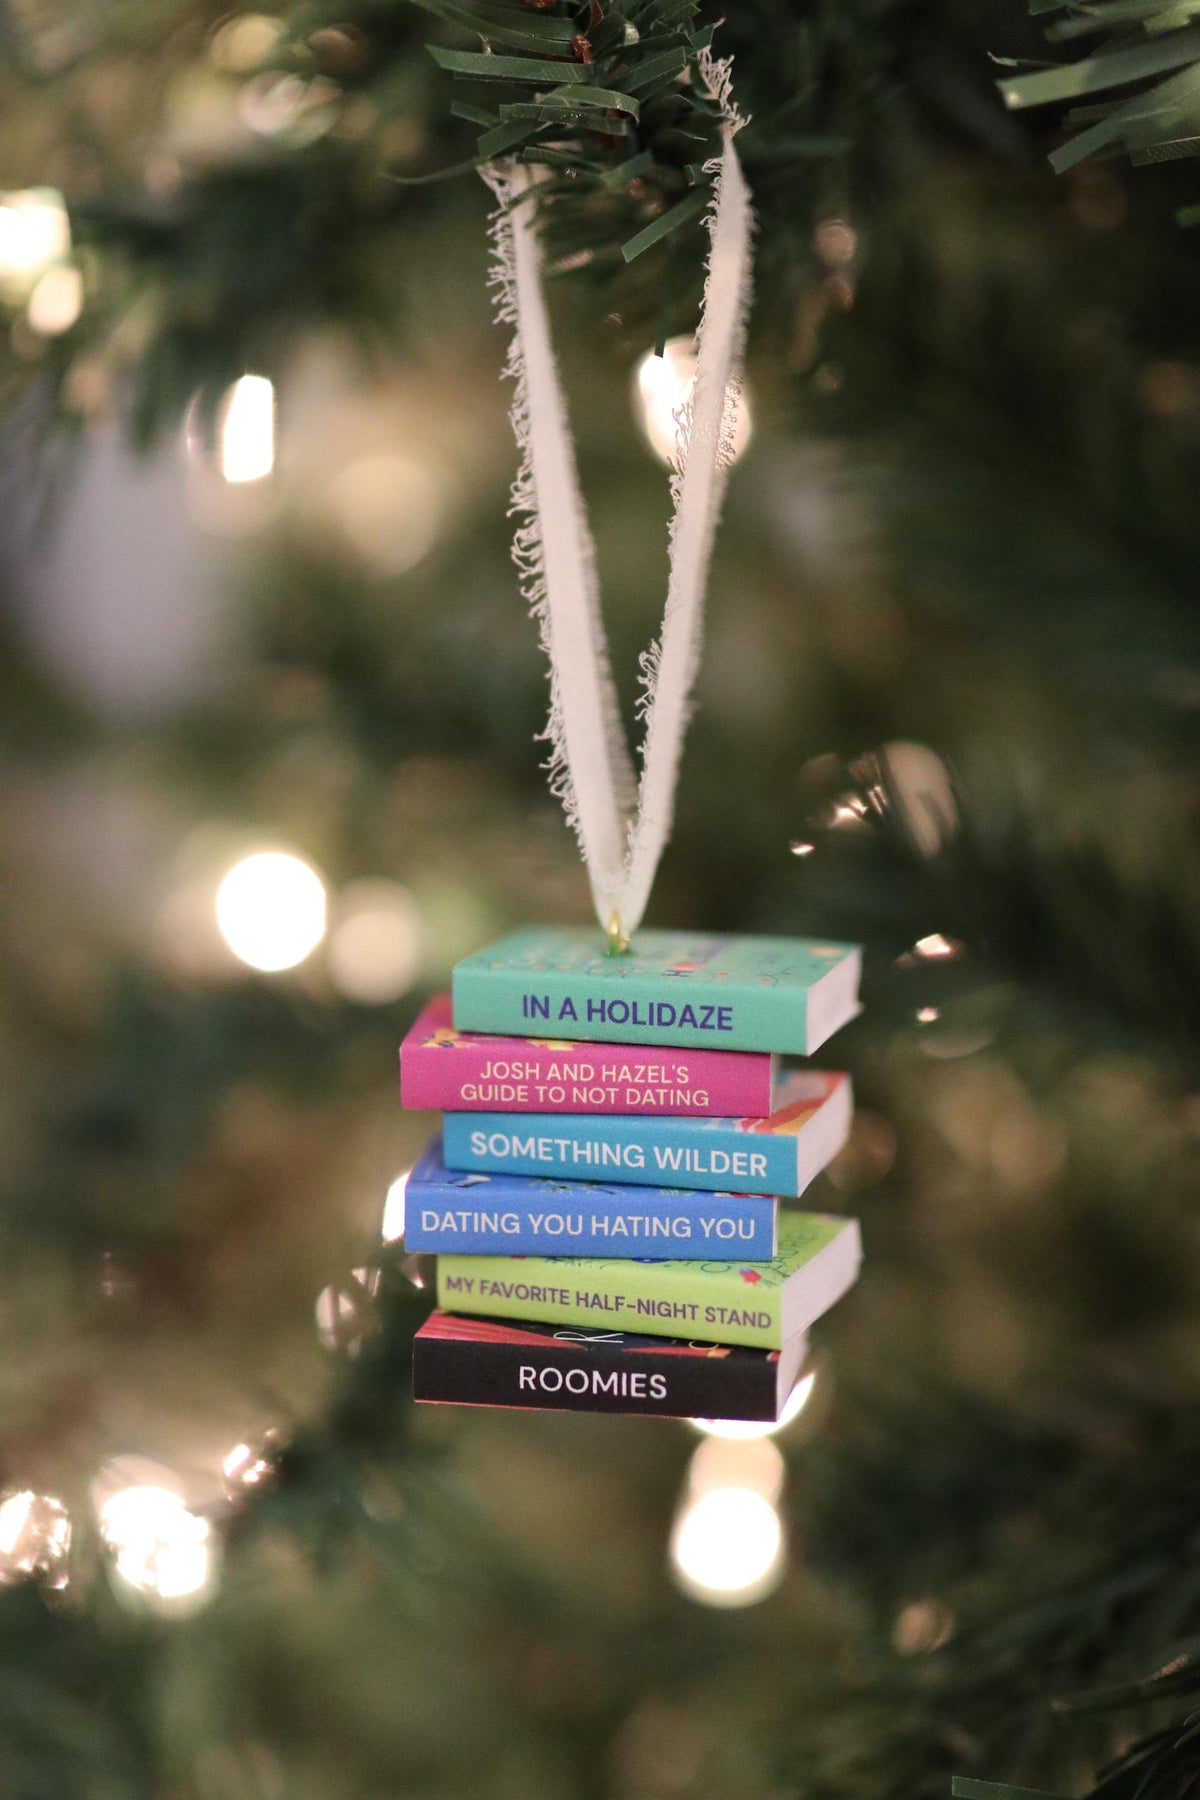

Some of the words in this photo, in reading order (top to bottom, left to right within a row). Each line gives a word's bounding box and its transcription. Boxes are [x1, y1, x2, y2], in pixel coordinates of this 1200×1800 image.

[521, 994, 550, 1020] IN
[558, 996, 579, 1022] A
[586, 998, 733, 1031] HOLIDAZE
[480, 1061, 540, 1080] JOSH
[546, 1062, 595, 1082] AND
[601, 1064, 690, 1084] HAZEL'S
[460, 1083, 529, 1102] GUIDE
[534, 1085, 566, 1103] TO
[572, 1086, 620, 1104] NOT
[625, 1087, 710, 1108] DATING
[470, 1131, 646, 1169] SOMETHING
[653, 1146, 768, 1178] WILDER
[421, 1210, 520, 1234] DATING
[527, 1213, 583, 1236] YOU
[591, 1215, 692, 1238] HATING
[699, 1217, 755, 1240] YOU
[446, 1275, 475, 1293] MY
[479, 1279, 571, 1306] FAVORITE
[575, 1291, 699, 1321] HALF-NIGHT
[704, 1307, 772, 1329] STAND
[519, 1365, 667, 1399] ROOMIES
